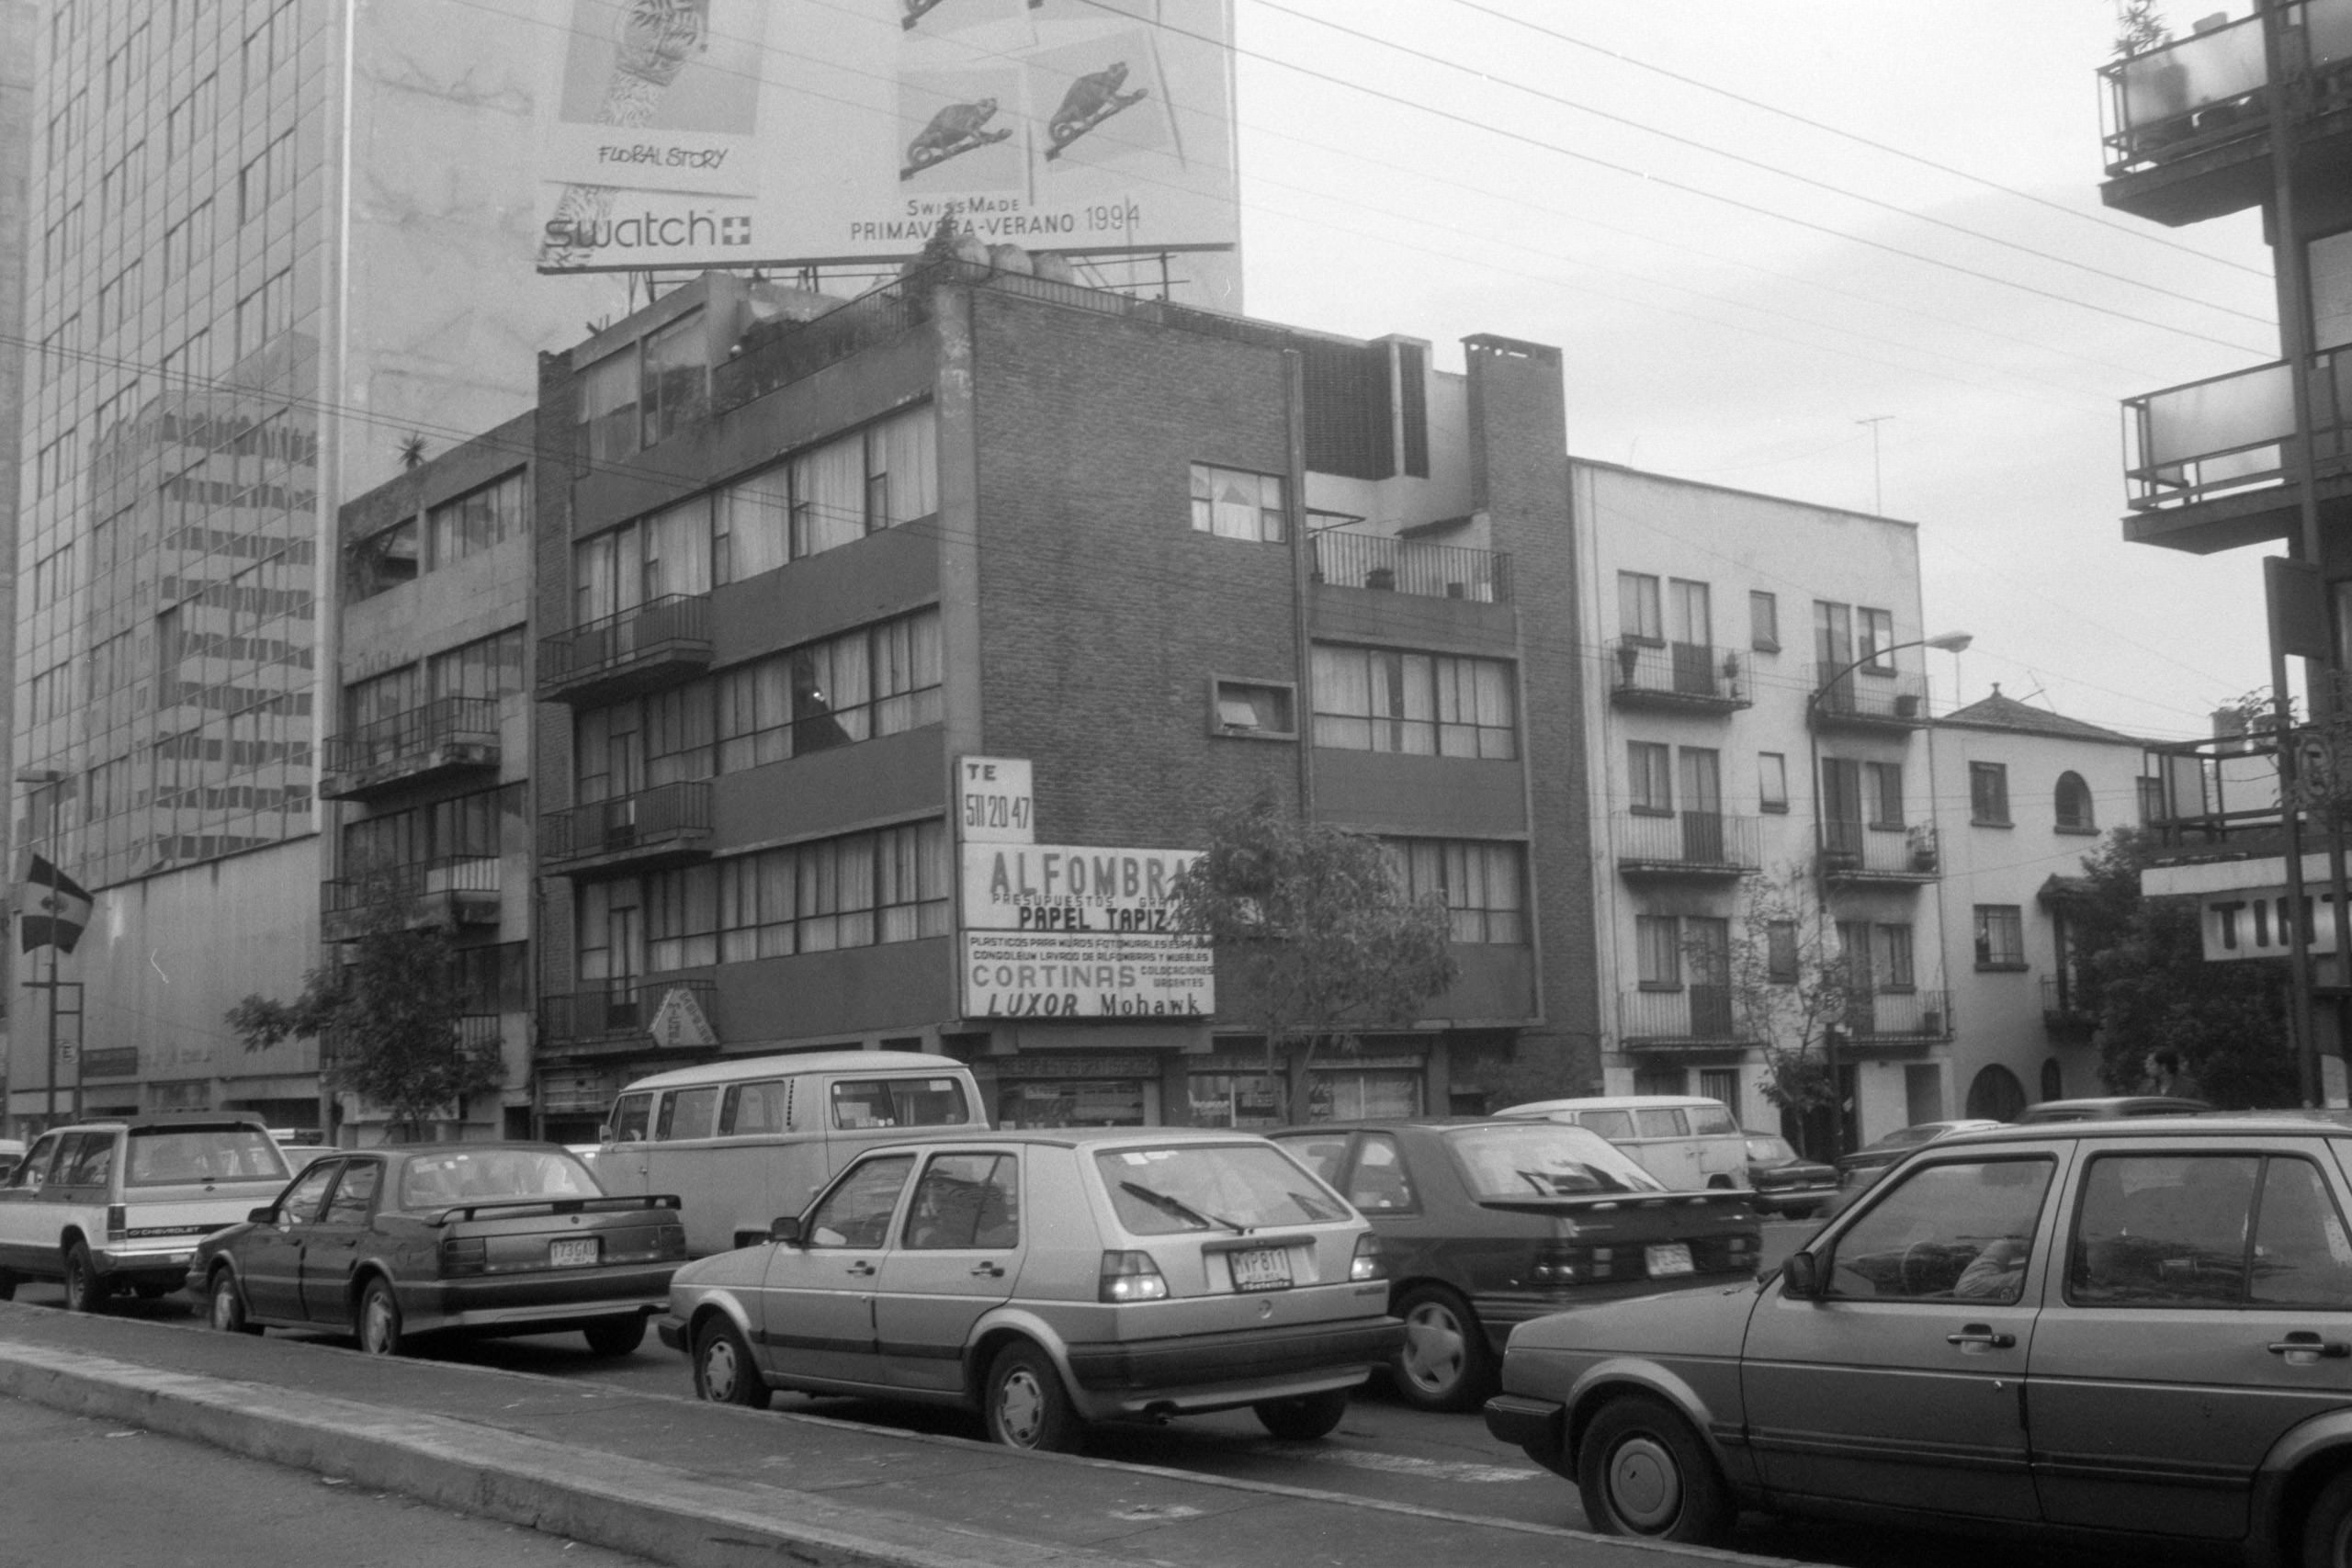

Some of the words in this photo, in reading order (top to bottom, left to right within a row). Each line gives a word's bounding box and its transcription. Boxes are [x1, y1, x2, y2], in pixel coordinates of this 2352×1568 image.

[544, 210, 716, 248] swatch
[851, 212, 1075, 241] PRIMAVRA-VERANO
[1085, 204, 1141, 231] 1994
[967, 762, 997, 781] TE
[966, 793, 986, 827] 511
[988, 795, 1008, 829] 20
[1012, 795, 1030, 829] 47
[992, 893, 1114, 908] PRESUPUESTOS
[1020, 906, 1091, 930] PAPEL
[1105, 908, 1166, 931] TAPIZ
[1030, 938, 1057, 947] PARA
[1082, 952, 1094, 962] DE
[1097, 952, 1156, 962] ALFOMBRAS
[1159, 953, 1165, 962] Y
[1167, 953, 1209, 962] MUEBLES
[972, 964, 1136, 988] CORTINAS
[988, 993, 1079, 1016] LUXOR
[1101, 993, 1201, 1015] Mohawk
[141, 1226, 201, 1235] CHEVROLET
